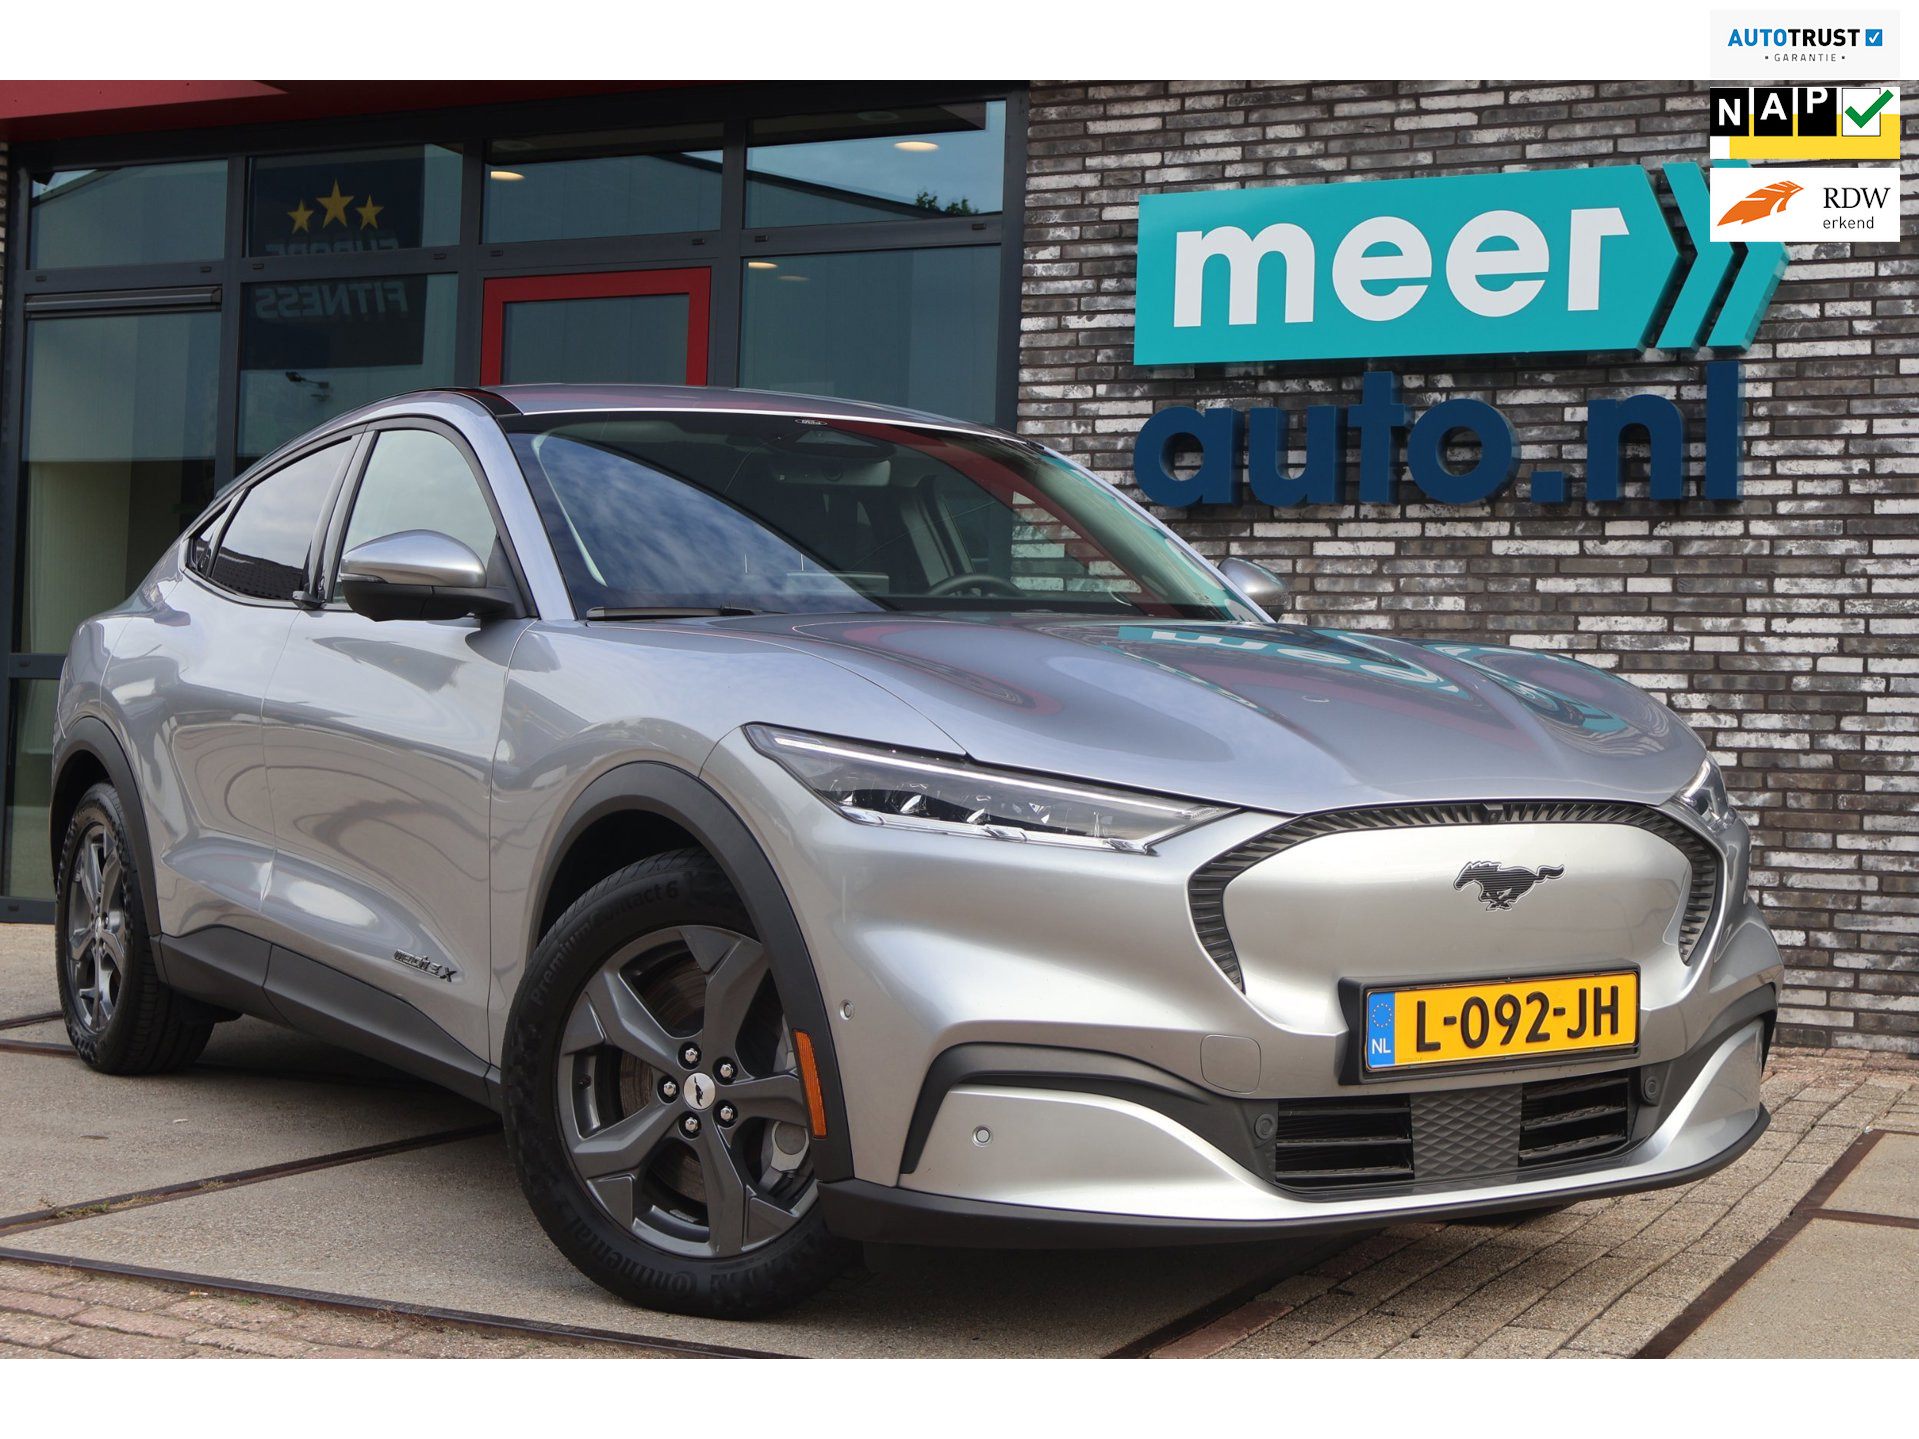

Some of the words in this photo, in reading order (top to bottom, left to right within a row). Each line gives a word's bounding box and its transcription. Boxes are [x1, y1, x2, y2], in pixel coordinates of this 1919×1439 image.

[1173, 206, 1630, 328] meer
[1133, 360, 1745, 506] auto.nl
[1371, 1037, 1391, 1055] NL
[1416, 985, 1619, 1053] L-092-JH
